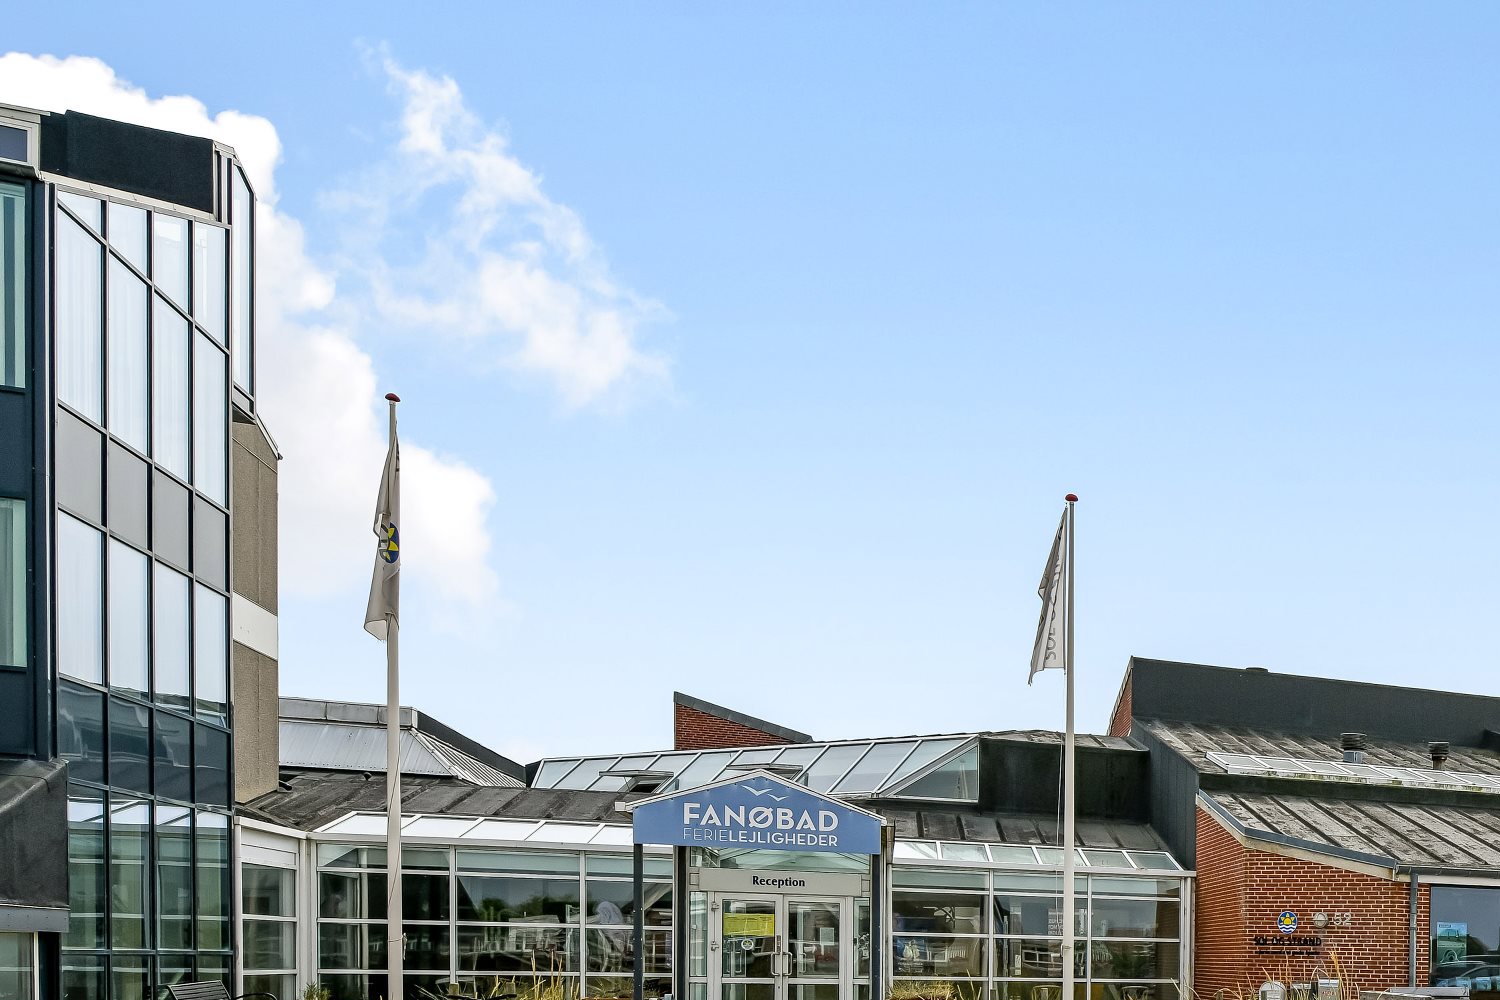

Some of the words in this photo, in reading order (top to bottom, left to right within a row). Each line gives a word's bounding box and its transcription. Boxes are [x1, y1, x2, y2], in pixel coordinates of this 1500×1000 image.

[683, 802, 838, 832] FANØBAD
[683, 827, 838, 847] FERIELEJLIGHEDER
[752, 875, 806, 889] Reception
[1333, 912, 1352, 926] 52
